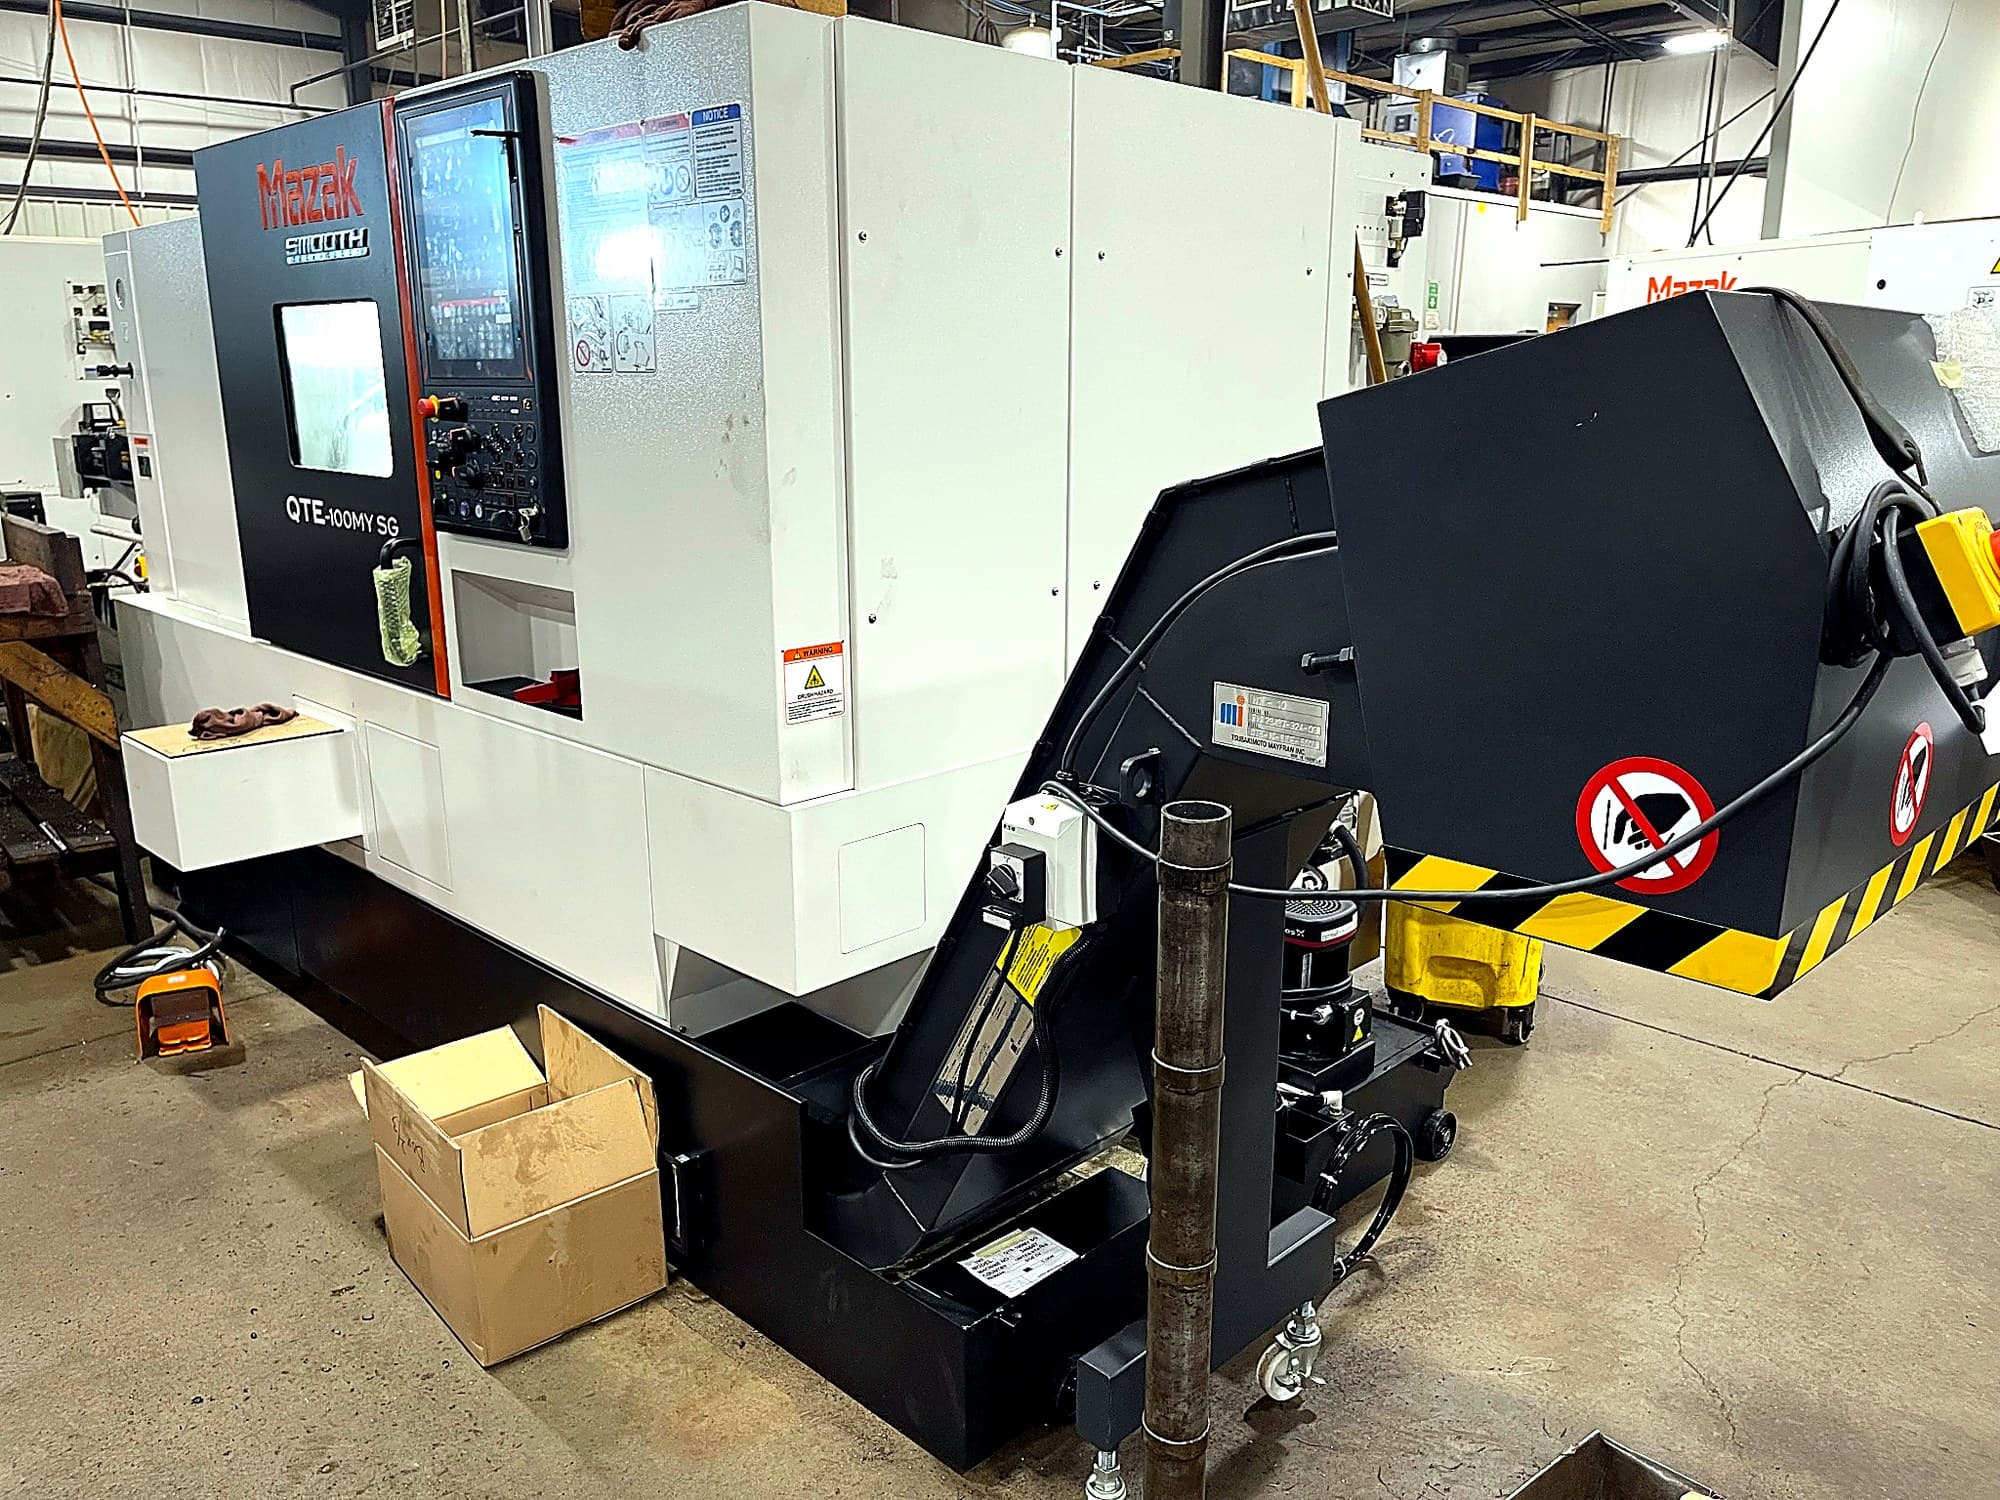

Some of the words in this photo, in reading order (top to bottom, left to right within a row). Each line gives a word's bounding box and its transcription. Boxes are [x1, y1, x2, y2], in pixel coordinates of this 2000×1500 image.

[702, 107, 729, 122] NOTICE
[256, 144, 365, 230] Mazak
[285, 228, 369, 256] SMOOTH
[286, 495, 374, 533] QTE-100MY
[376, 515, 399, 537] SG
[803, 646, 833, 657] WARNING
[1268, 741, 1295, 754] MAYFRAN
